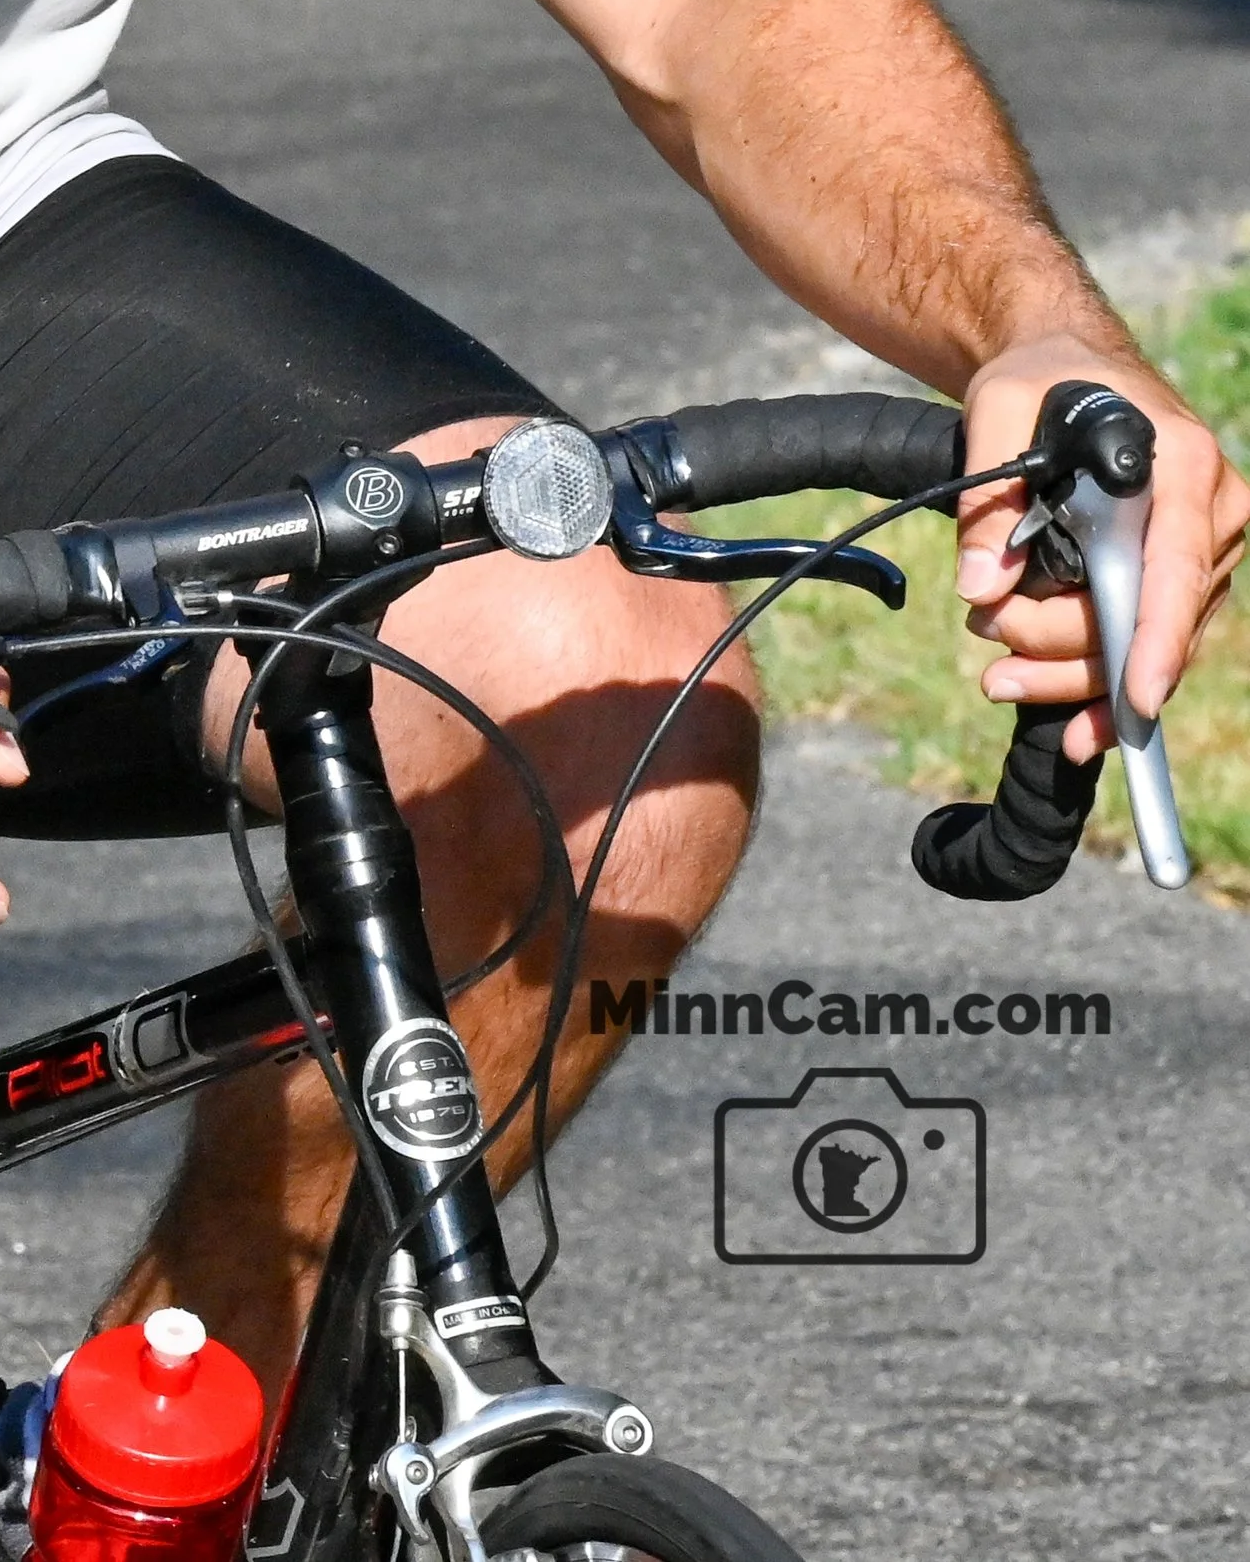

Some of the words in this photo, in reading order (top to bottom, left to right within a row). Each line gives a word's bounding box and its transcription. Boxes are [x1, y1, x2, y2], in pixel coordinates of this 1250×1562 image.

[355, 473, 393, 513] B
[197, 518, 309, 552] BONTRAGER
[370, 1075, 474, 1112] TREK
[479, 1307, 491, 1318] IN
